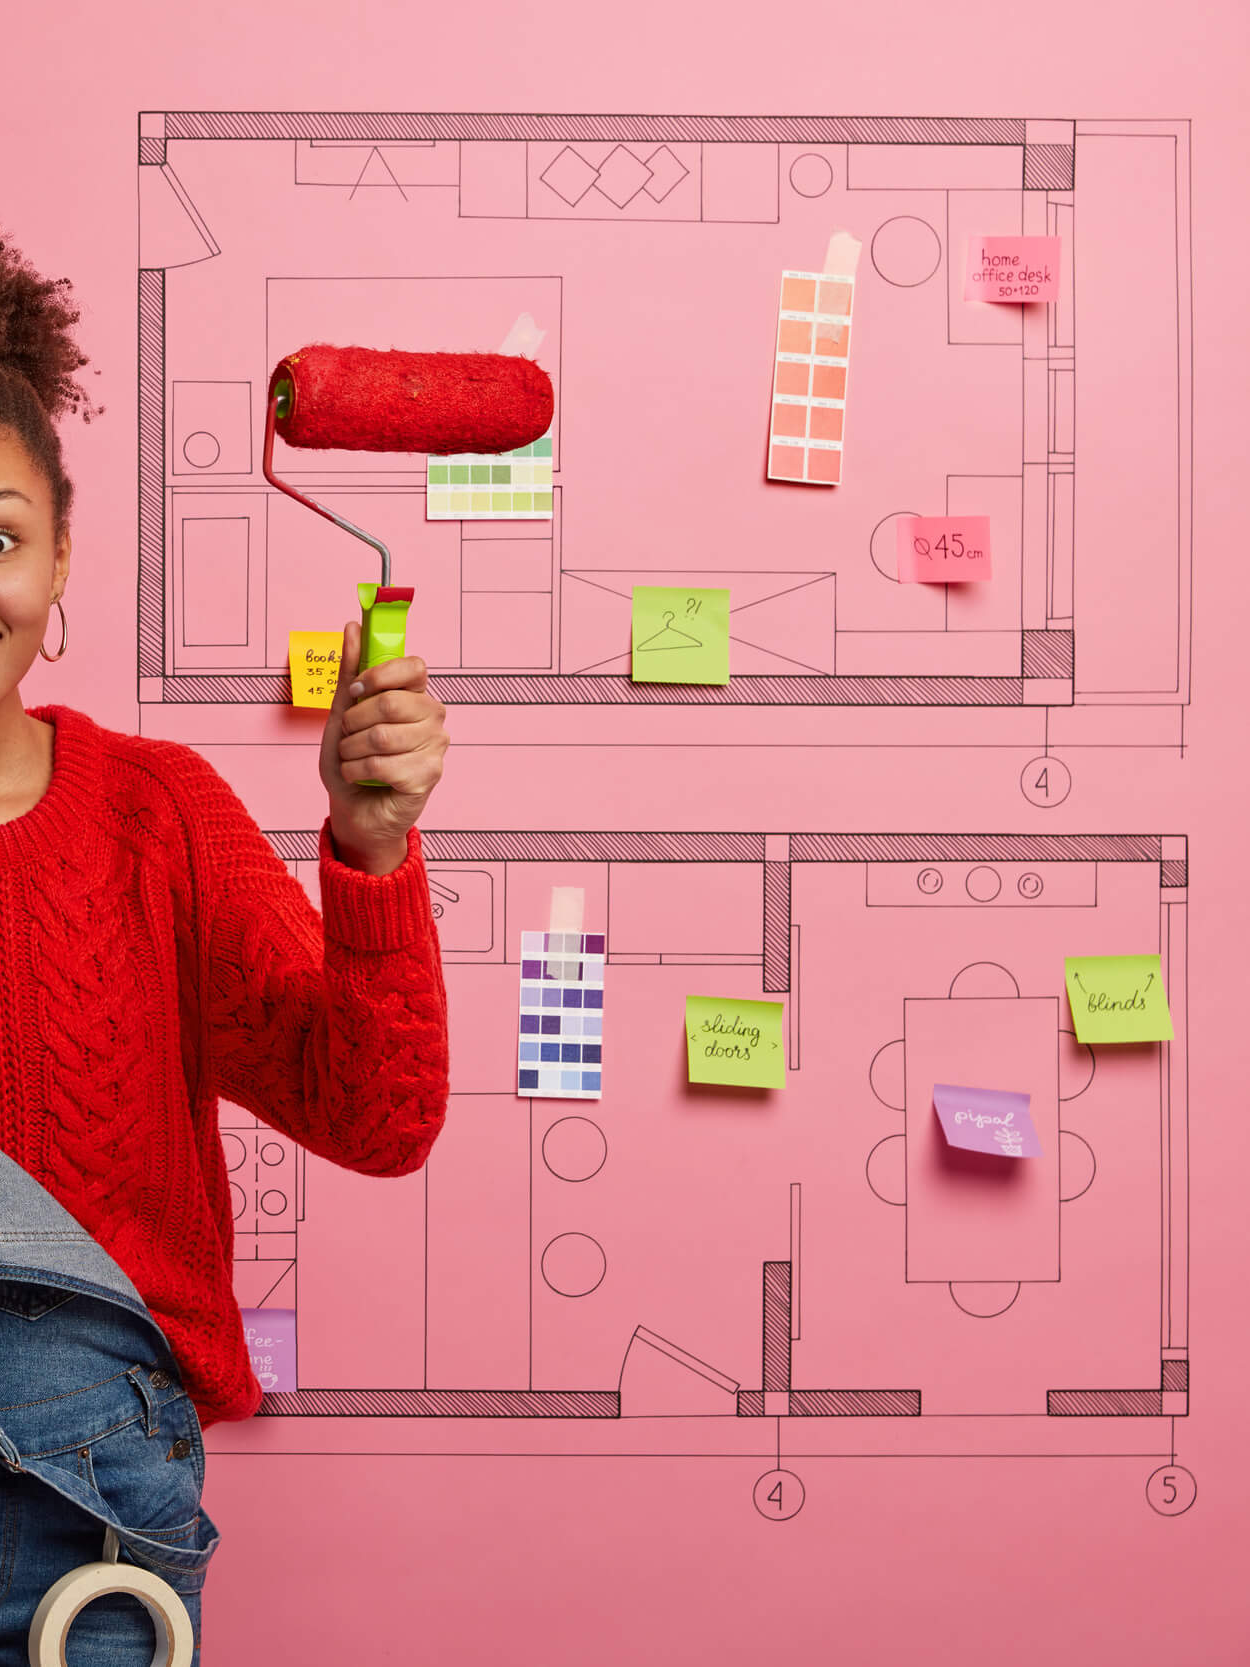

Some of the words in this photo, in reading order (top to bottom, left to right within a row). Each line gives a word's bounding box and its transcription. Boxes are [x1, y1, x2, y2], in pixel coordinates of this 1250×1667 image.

[981, 247, 1020, 267] home
[972, 266, 1014, 283] office
[1017, 263, 1052, 283] desk
[305, 668, 325, 676] 35
[307, 687, 325, 696] 45
[1035, 767, 1049, 798] 4
[1087, 989, 1147, 1014] blinds
[701, 1013, 760, 1048] sliding
[704, 1039, 751, 1061] doors
[767, 1481, 782, 1511] 4
[1162, 1475, 1177, 1504] 5
